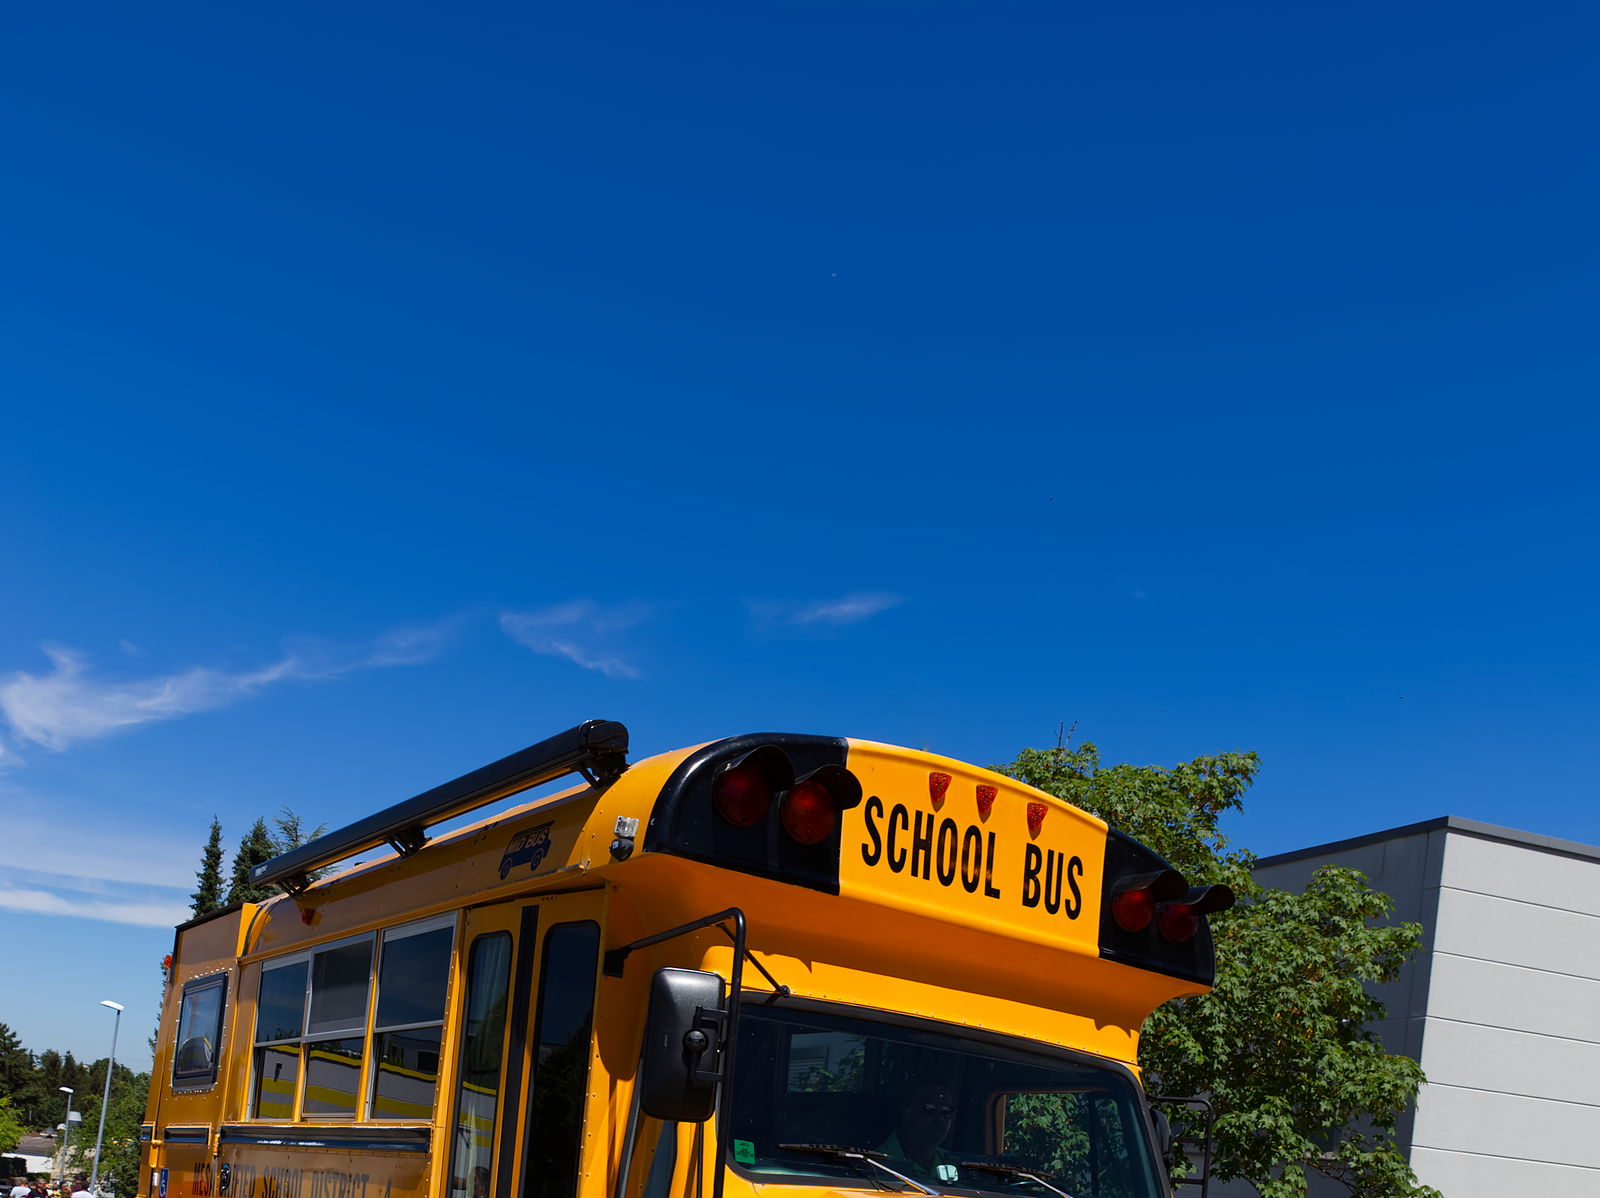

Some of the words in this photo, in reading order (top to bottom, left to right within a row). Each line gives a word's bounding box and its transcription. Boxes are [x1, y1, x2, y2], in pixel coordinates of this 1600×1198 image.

[525, 831, 546, 848] BUS
[861, 795, 1001, 900] SCHOOL
[1022, 842, 1083, 921] BUS
